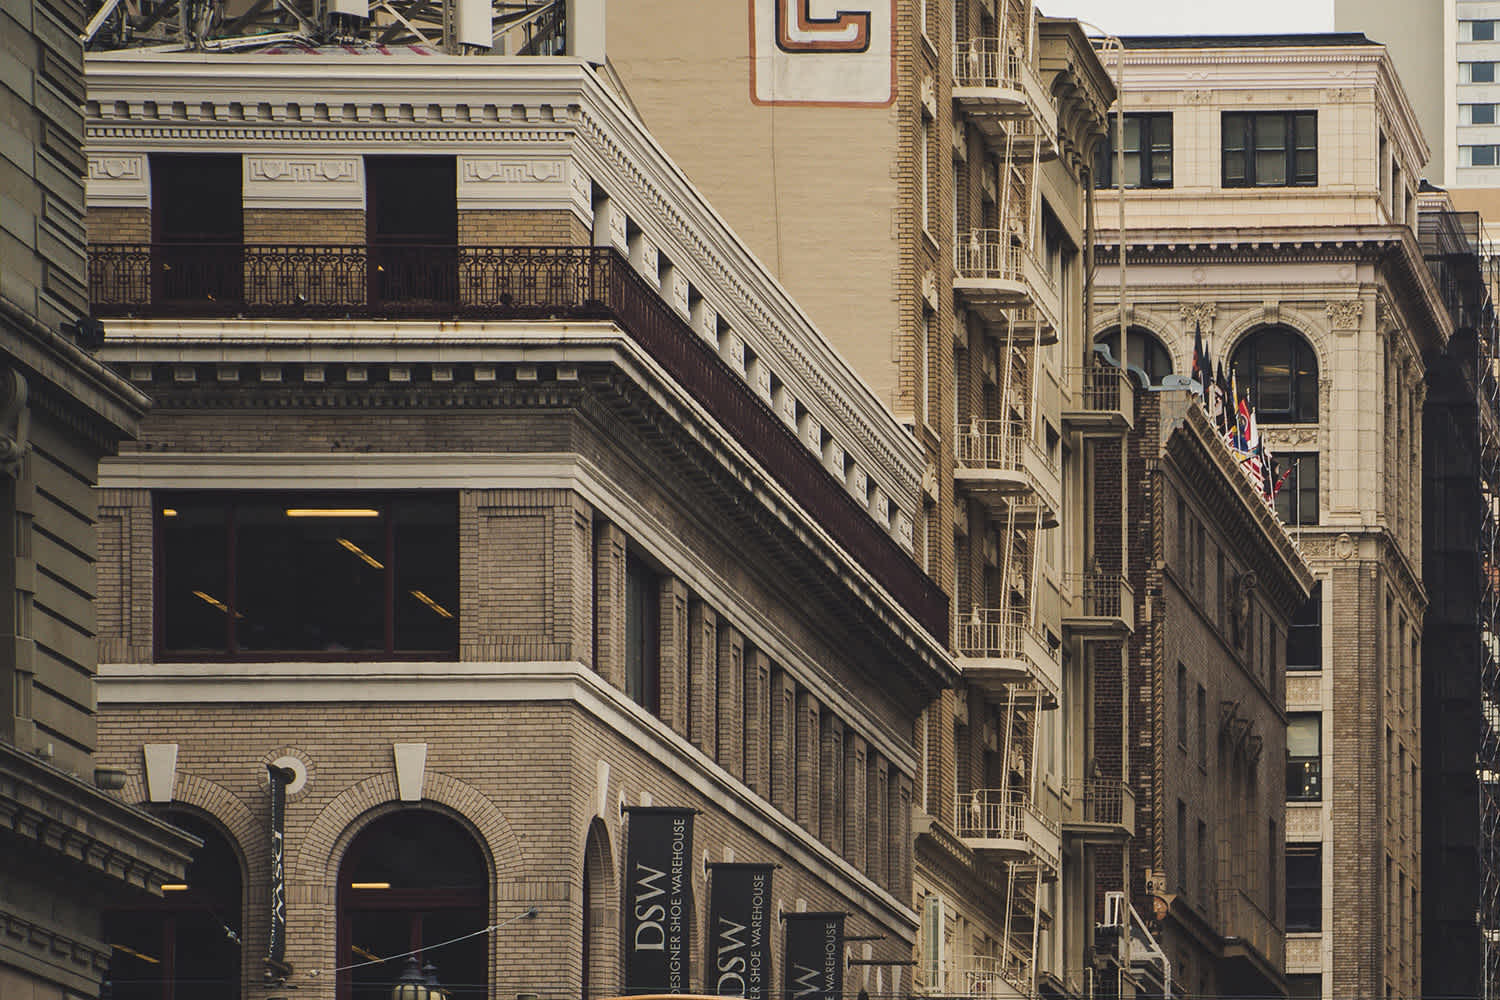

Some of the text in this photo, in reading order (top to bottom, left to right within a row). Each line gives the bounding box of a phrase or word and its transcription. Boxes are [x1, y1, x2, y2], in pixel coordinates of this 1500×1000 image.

[634, 861, 667, 952] DSW
[669, 819, 685, 995] DESIGNER SHOE WAREHOUSE
[751, 874, 764, 948] WAREHOUSE
[717, 916, 747, 999] DSW
[750, 951, 762, 983] SHOE
[825, 922, 837, 992] WAREHOUSE
